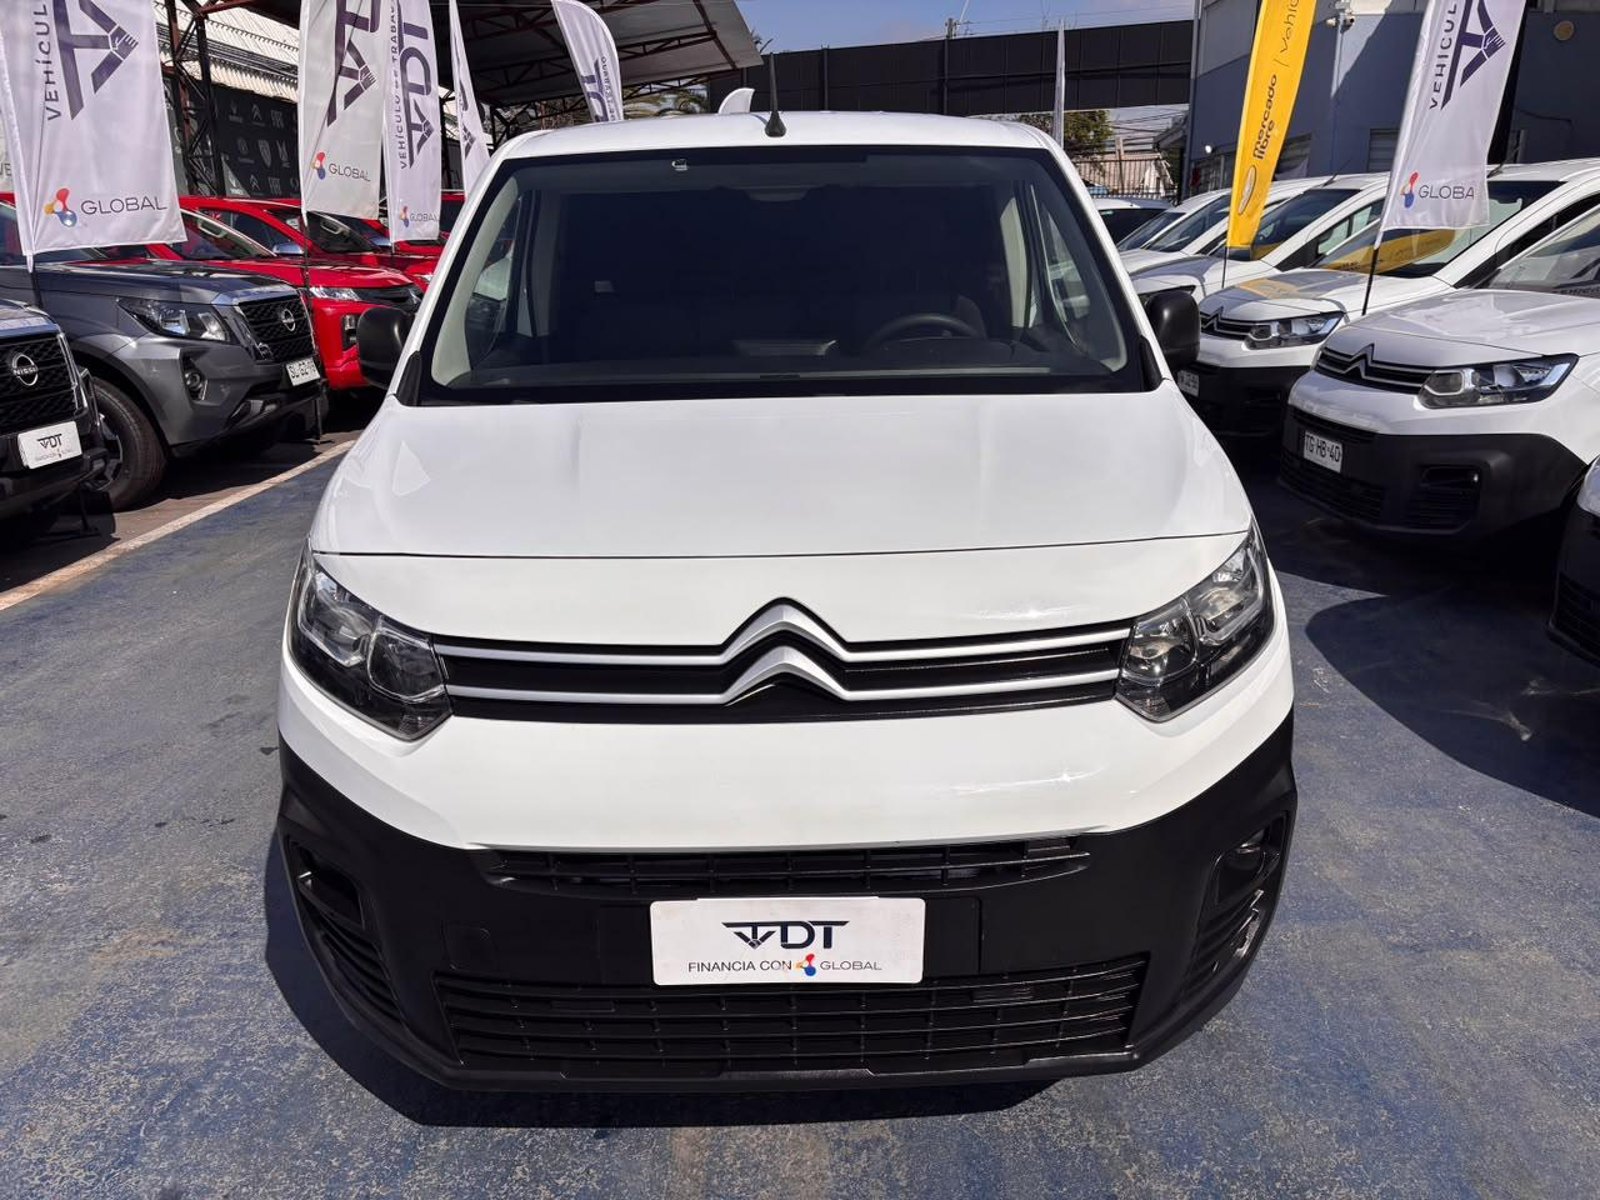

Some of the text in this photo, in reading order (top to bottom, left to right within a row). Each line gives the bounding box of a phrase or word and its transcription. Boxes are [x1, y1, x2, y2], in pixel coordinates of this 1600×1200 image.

[1252, 74, 1277, 157] mercado
[1256, 120, 1275, 160] libre
[329, 163, 371, 182] GLOBAL
[81, 196, 168, 216] GLOBAL
[721, 920, 850, 949] VDT
[688, 959, 882, 973] FINANCIA CON GLOBAL
